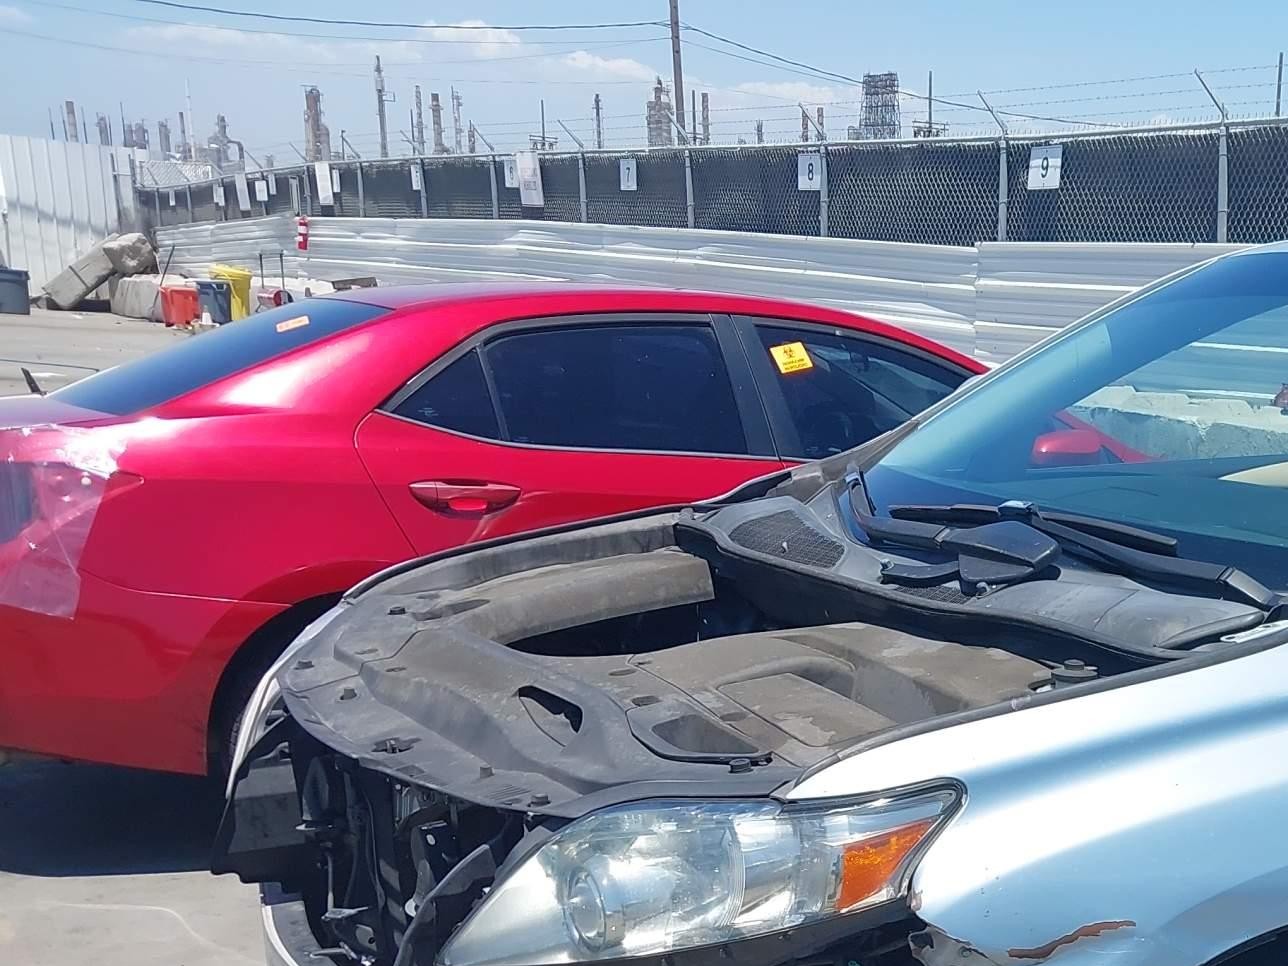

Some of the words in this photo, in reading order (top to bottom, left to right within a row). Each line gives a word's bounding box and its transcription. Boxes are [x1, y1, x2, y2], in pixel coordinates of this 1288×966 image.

[625, 166, 631, 183] 7
[807, 162, 814, 181] 8
[1040, 156, 1049, 178] 9
